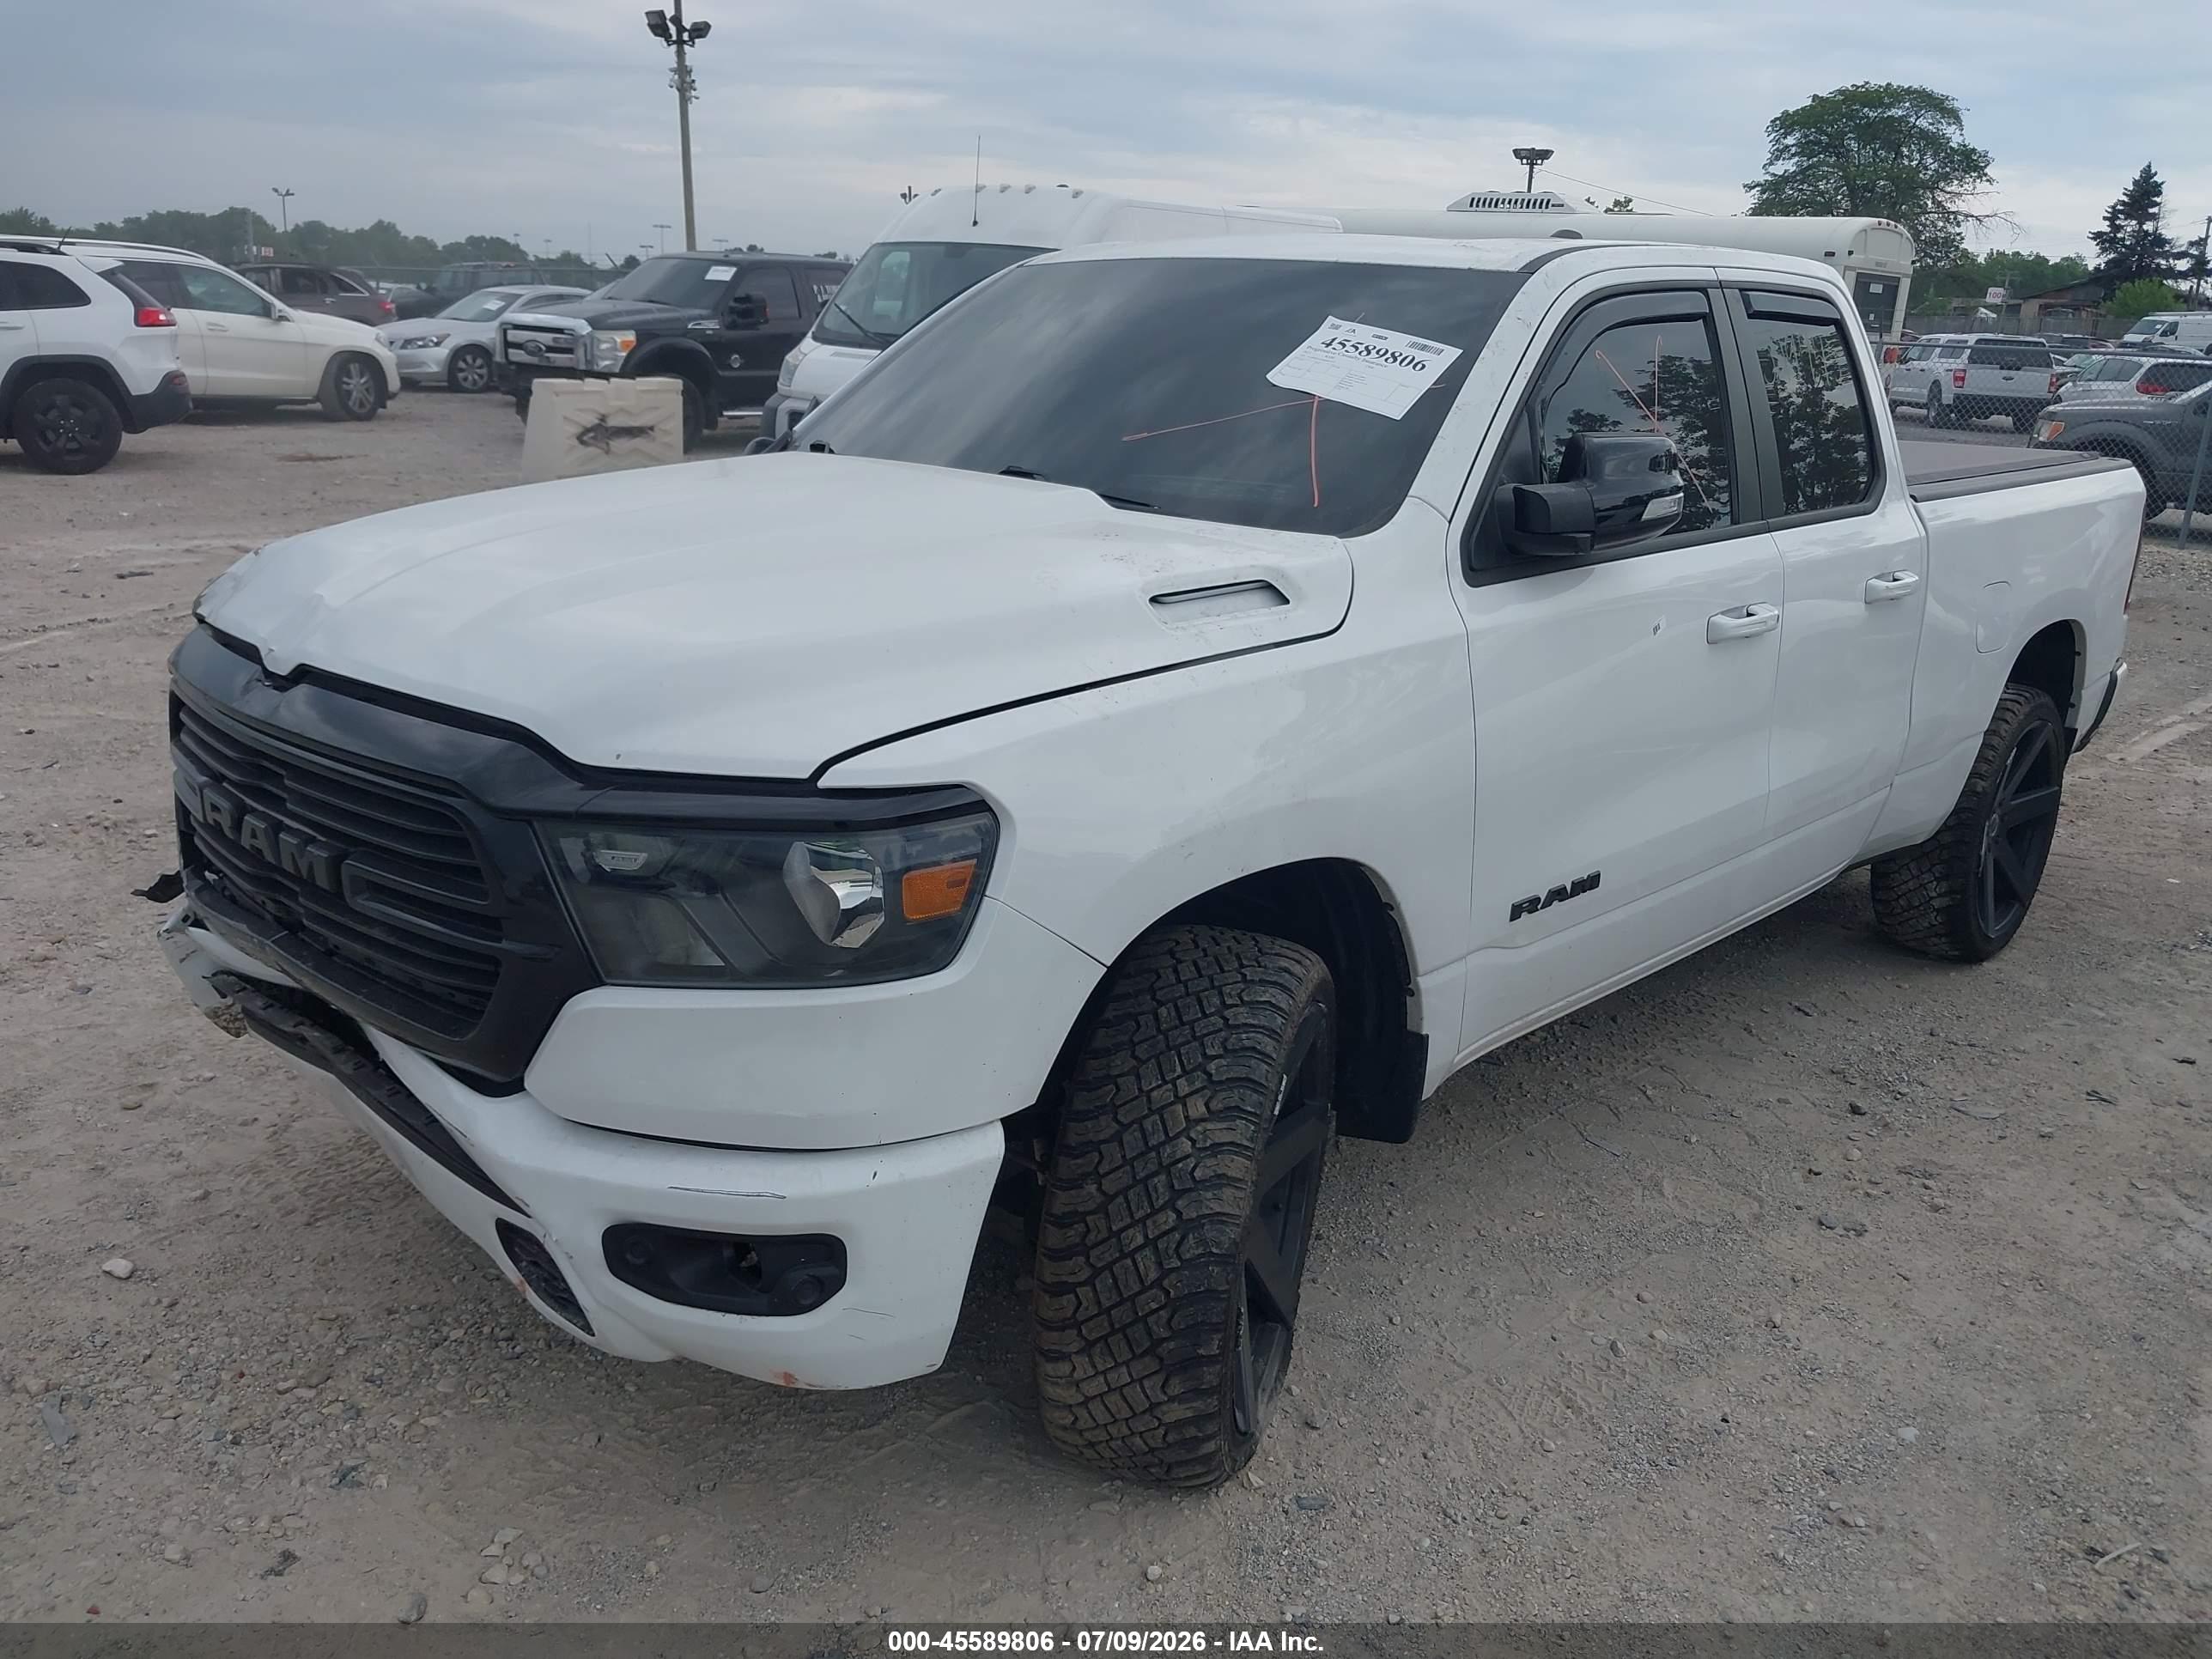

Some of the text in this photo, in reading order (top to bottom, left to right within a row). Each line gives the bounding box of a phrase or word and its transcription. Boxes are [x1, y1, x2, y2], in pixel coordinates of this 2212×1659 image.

[1321, 337, 1431, 372] 45589806
[203, 787, 338, 894] RAM
[1509, 870, 1601, 922] RAM
